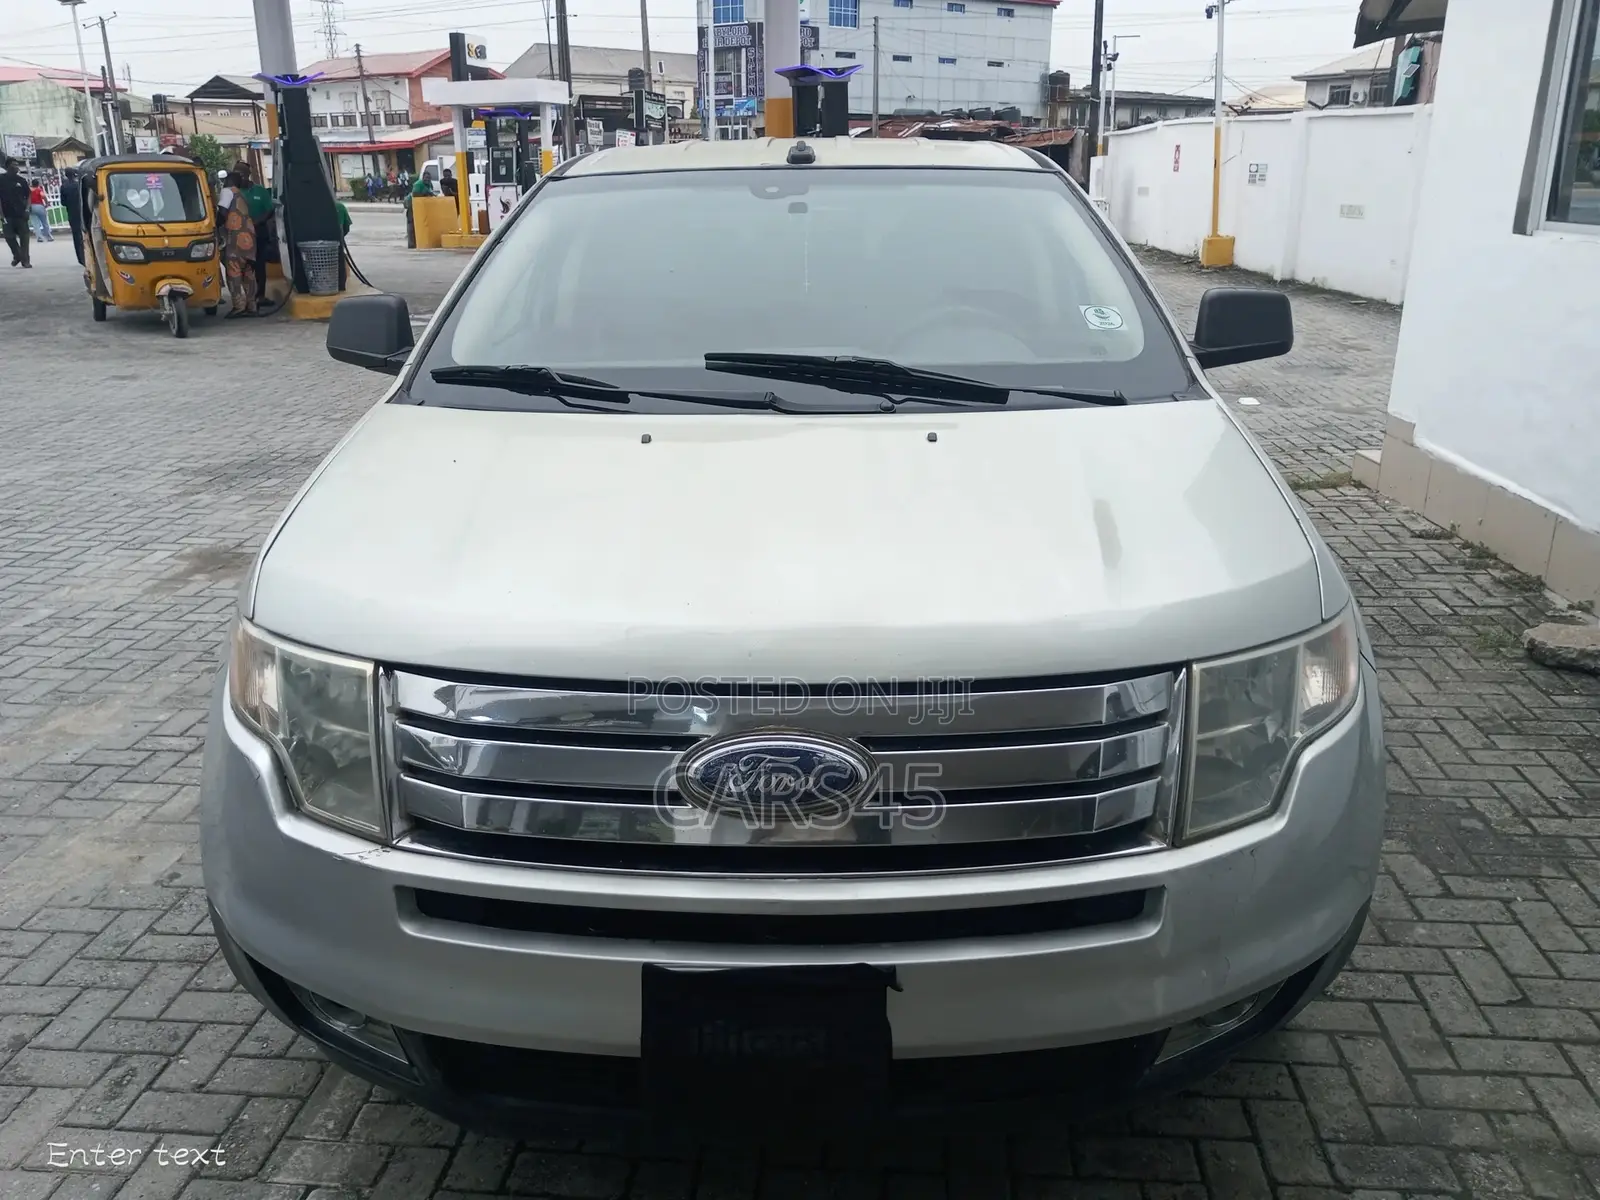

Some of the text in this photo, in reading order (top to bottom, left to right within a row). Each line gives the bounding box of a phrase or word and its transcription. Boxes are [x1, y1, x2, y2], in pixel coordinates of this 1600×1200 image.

[724, 35, 753, 47] DEPOT
[747, 47, 756, 97] SALON
[729, 753, 817, 793] Ford
